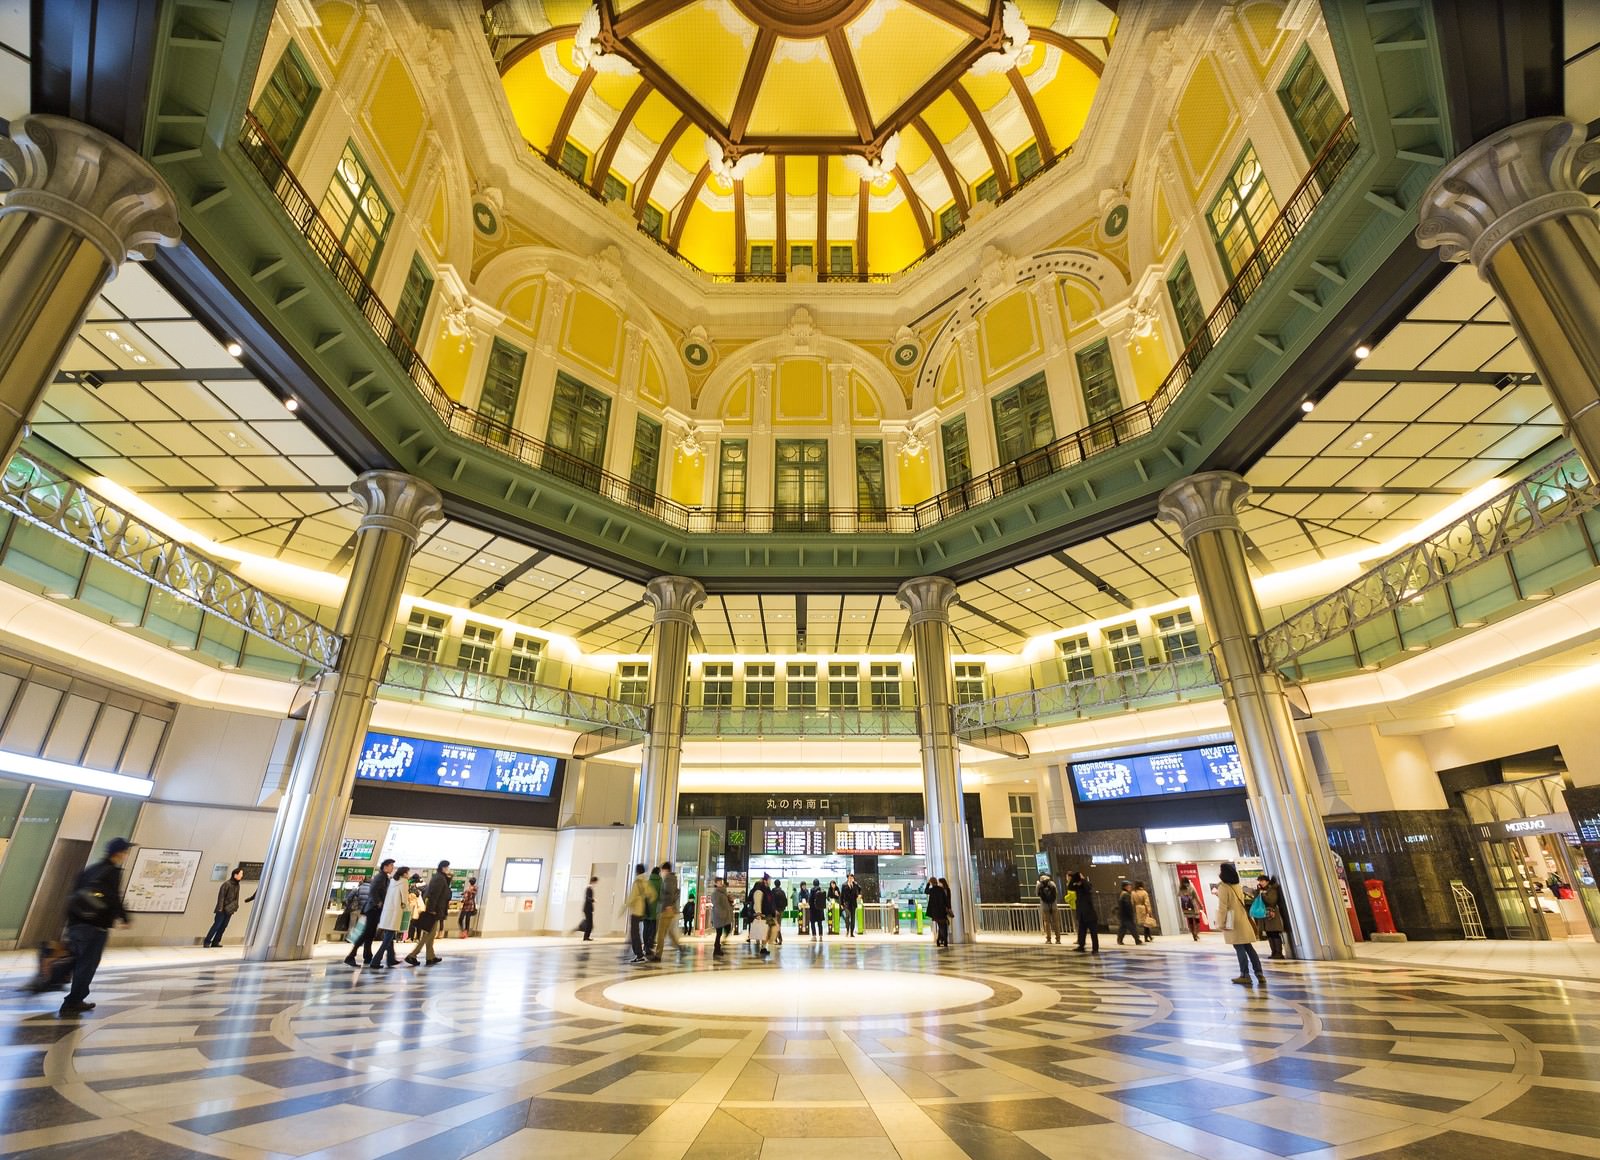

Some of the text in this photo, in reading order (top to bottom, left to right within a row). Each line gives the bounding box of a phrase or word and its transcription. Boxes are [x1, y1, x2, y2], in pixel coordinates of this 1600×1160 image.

[1213, 744, 1235, 755] AFTER
[1072, 761, 1107, 772] TOMORROW
[766, 798, 830, 809] 丸の内南口
